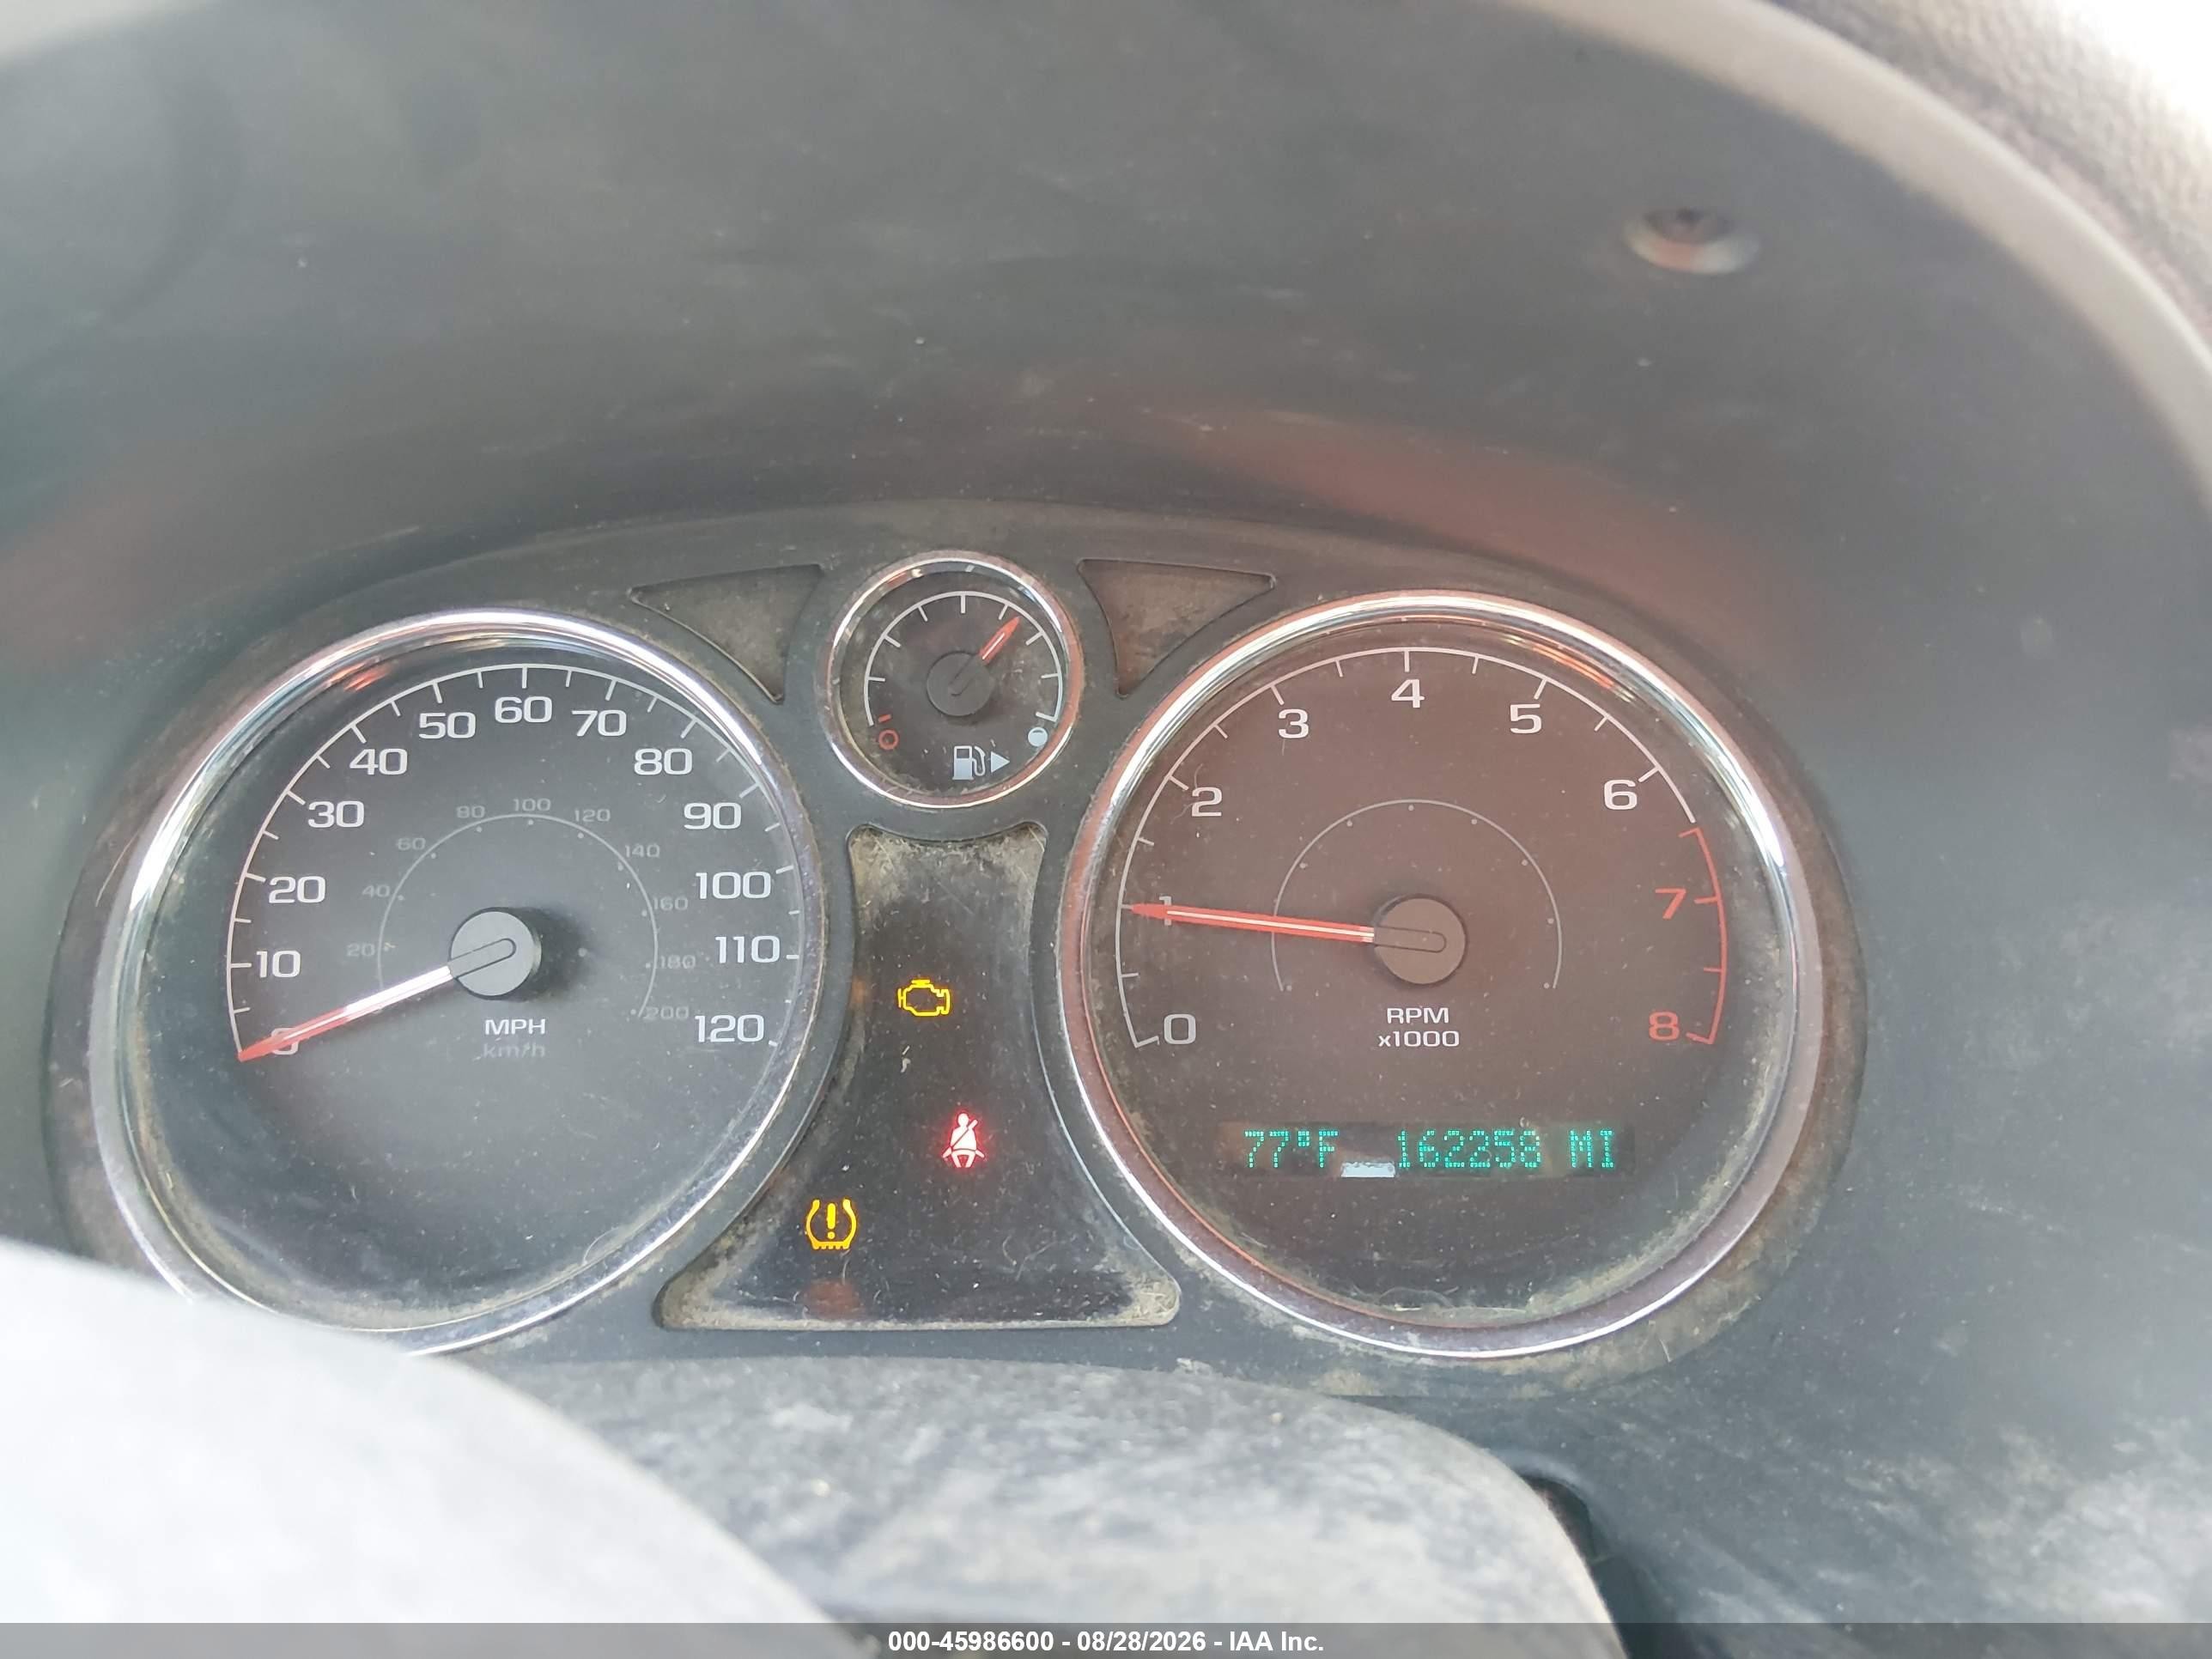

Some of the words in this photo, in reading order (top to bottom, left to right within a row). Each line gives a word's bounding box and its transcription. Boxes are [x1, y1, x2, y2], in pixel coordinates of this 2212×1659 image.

[1391, 680, 1425, 707] 4
[494, 696, 553, 721] 60
[1510, 703, 1542, 733] 5
[417, 712, 476, 738] 50
[572, 709, 628, 736] 70
[1278, 709, 1309, 737] 3
[349, 749, 408, 774] 40
[634, 749, 693, 774] 80
[514, 799, 550, 810] 100
[1191, 787, 1222, 815] 2
[1603, 780, 1637, 808] 6
[307, 800, 365, 827] 30
[456, 805, 484, 817] 80
[574, 809, 611, 821] 120
[683, 803, 742, 828] 90
[397, 837, 426, 849] 60
[625, 845, 660, 856] 140
[268, 877, 325, 902] 20
[362, 885, 390, 897] 40
[695, 872, 771, 898] 100
[653, 896, 688, 909] 160
[1655, 888, 1686, 917] 7
[347, 944, 376, 956] 20
[714, 937, 781, 962] 110
[258, 951, 301, 976] 10
[644, 1006, 689, 1018] 200
[1387, 1007, 1449, 1022] RPM
[484, 1018, 545, 1034] MPH
[694, 1015, 765, 1041] 120
[1164, 1014, 1196, 1042] 0
[1648, 1012, 1680, 1039] 8
[483, 1041, 545, 1056] km/h
[1379, 1031, 1459, 1046] x1000
[1397, 1130, 1540, 1166] 162258
[1571, 1130, 1613, 1166] MI
